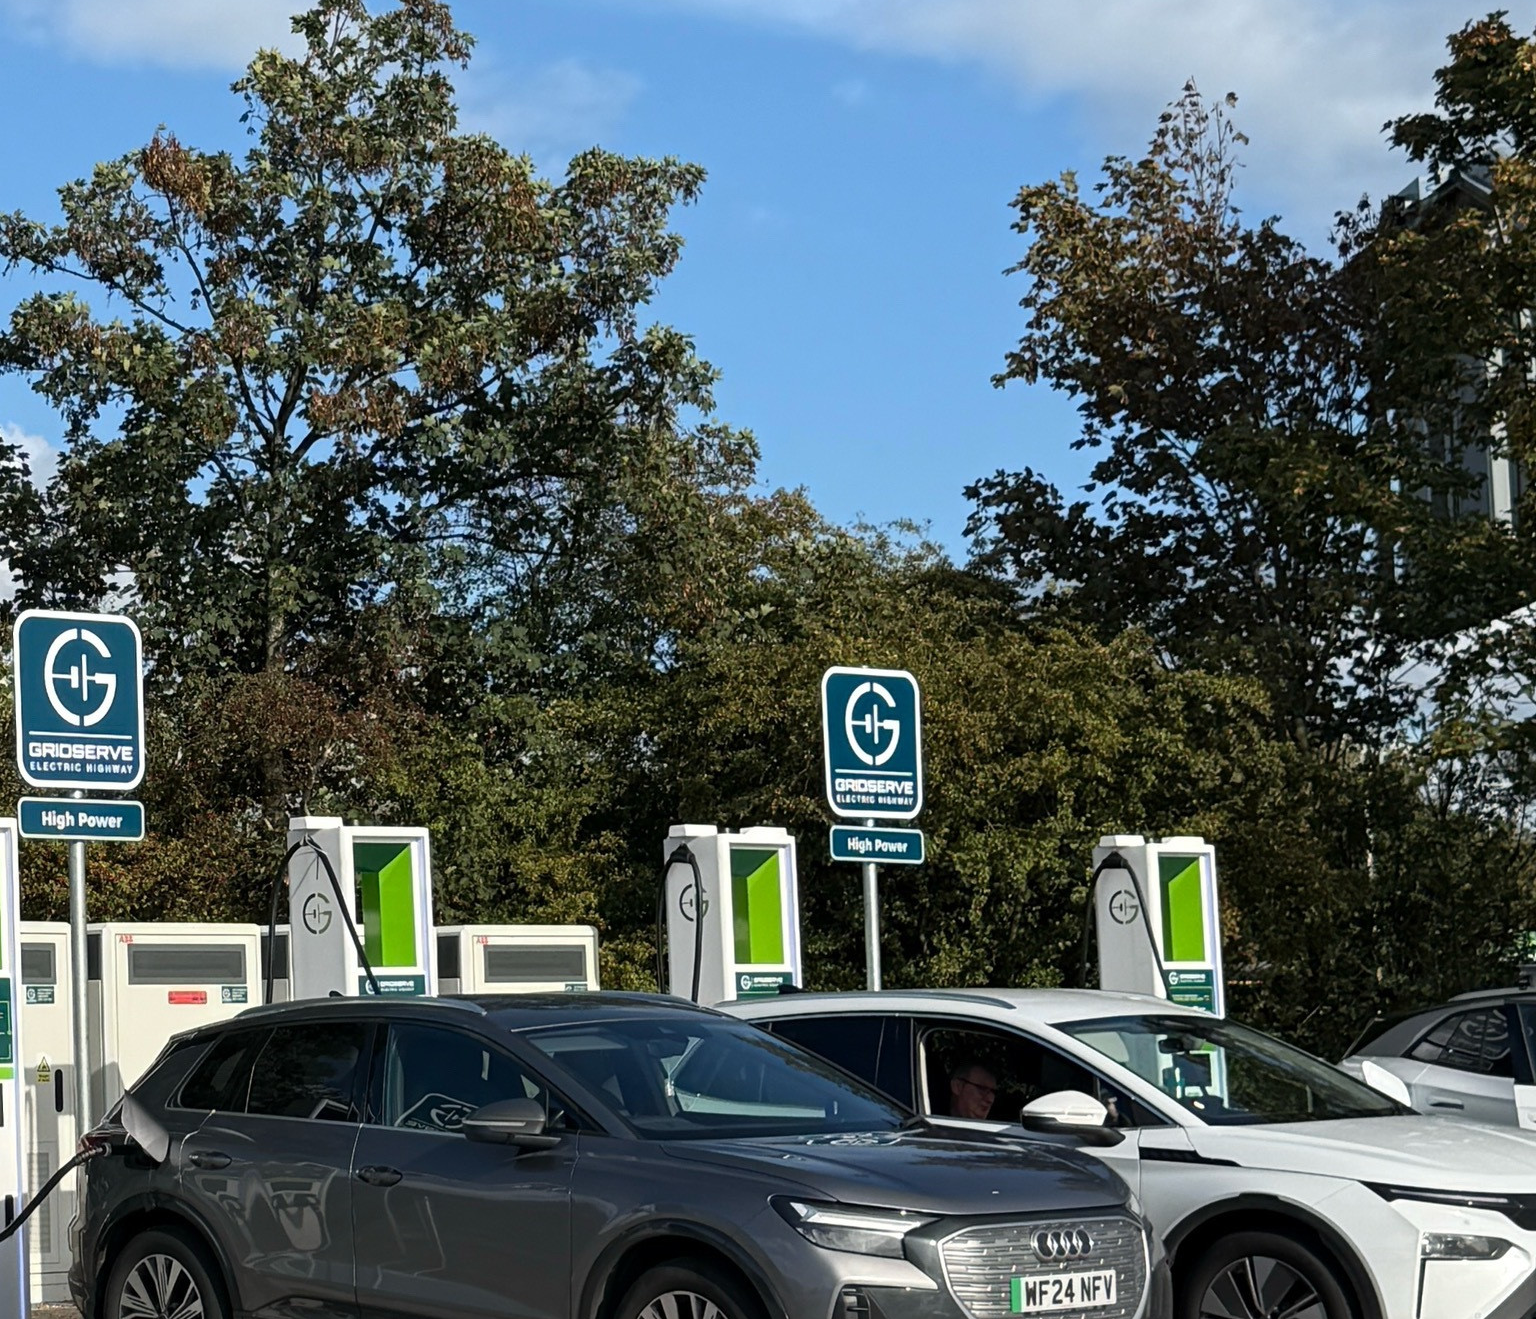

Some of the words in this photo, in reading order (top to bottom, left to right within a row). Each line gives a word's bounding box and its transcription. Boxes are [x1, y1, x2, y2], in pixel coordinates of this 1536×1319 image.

[28, 742, 134, 761] GRIDSERVE
[30, 761, 82, 773] ELECTRIC
[86, 763, 133, 774] HIGHWAY
[834, 778, 914, 795] GRIDSERVE
[836, 794, 875, 804] ELECTRIC
[41, 810, 75, 830] High
[78, 812, 123, 829] Power
[847, 836, 872, 854] High
[875, 838, 908, 853] Power
[1025, 1278, 1075, 1306] WF24
[1081, 1275, 1113, 1302] NFV
